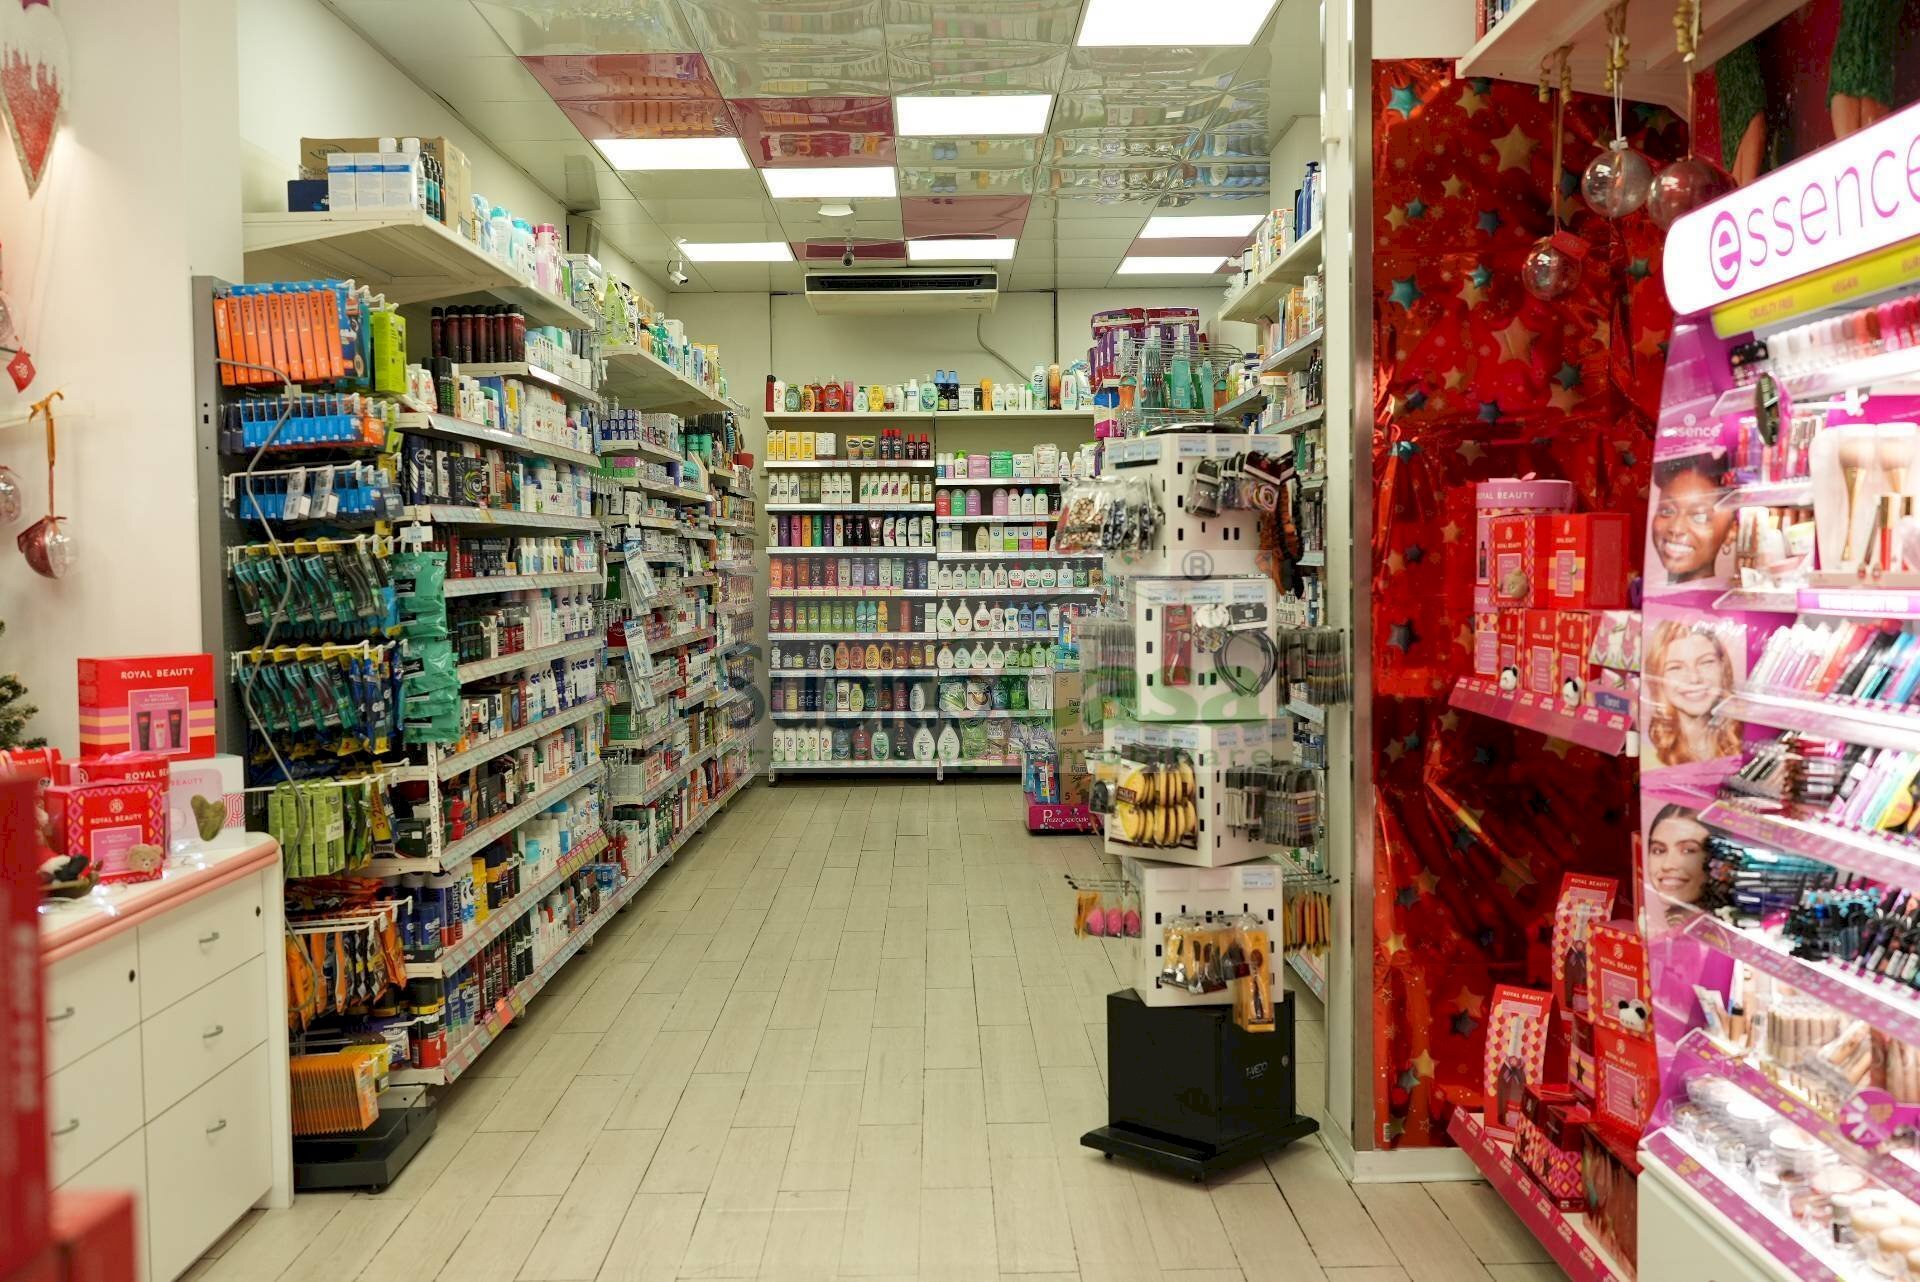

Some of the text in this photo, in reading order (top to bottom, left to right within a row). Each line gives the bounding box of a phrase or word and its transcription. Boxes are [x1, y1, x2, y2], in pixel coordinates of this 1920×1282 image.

[1497, 491, 1536, 500] BEAUTY
[120, 667, 194, 680] ROYAL BEAUTY
[124, 770, 157, 781] ROYAL
[90, 813, 143, 825] ROYAL BEAUTY
[1043, 809, 1062, 823] Prezzo
[1502, 990, 1544, 1002] ROYAL BEAUTY
